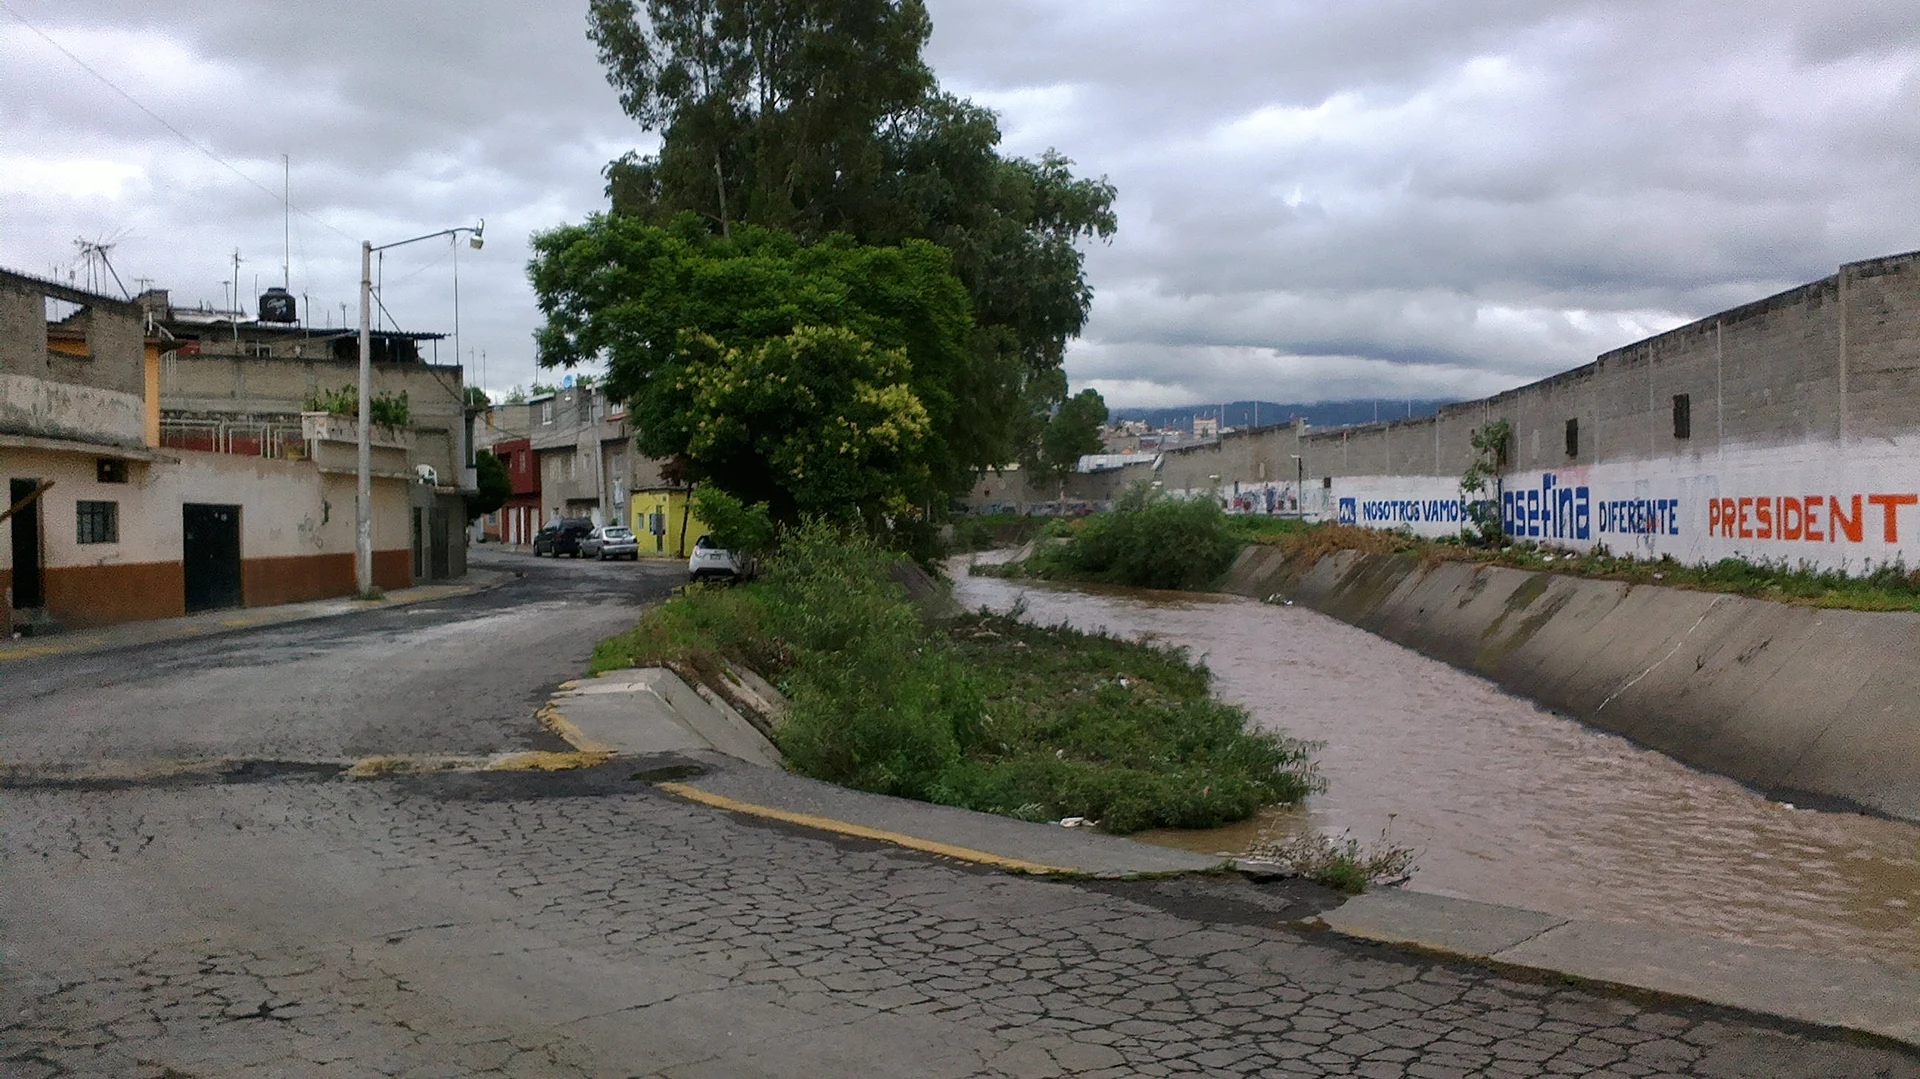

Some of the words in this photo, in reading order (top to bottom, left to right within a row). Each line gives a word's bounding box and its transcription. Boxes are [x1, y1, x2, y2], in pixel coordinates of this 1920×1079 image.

[1362, 500, 1420, 522] NOSOTROS
[1422, 496, 1467, 522] VAMOS
[1599, 498, 1679, 535] DIFERENTE
[1709, 494, 1918, 543] PRESIDENT
